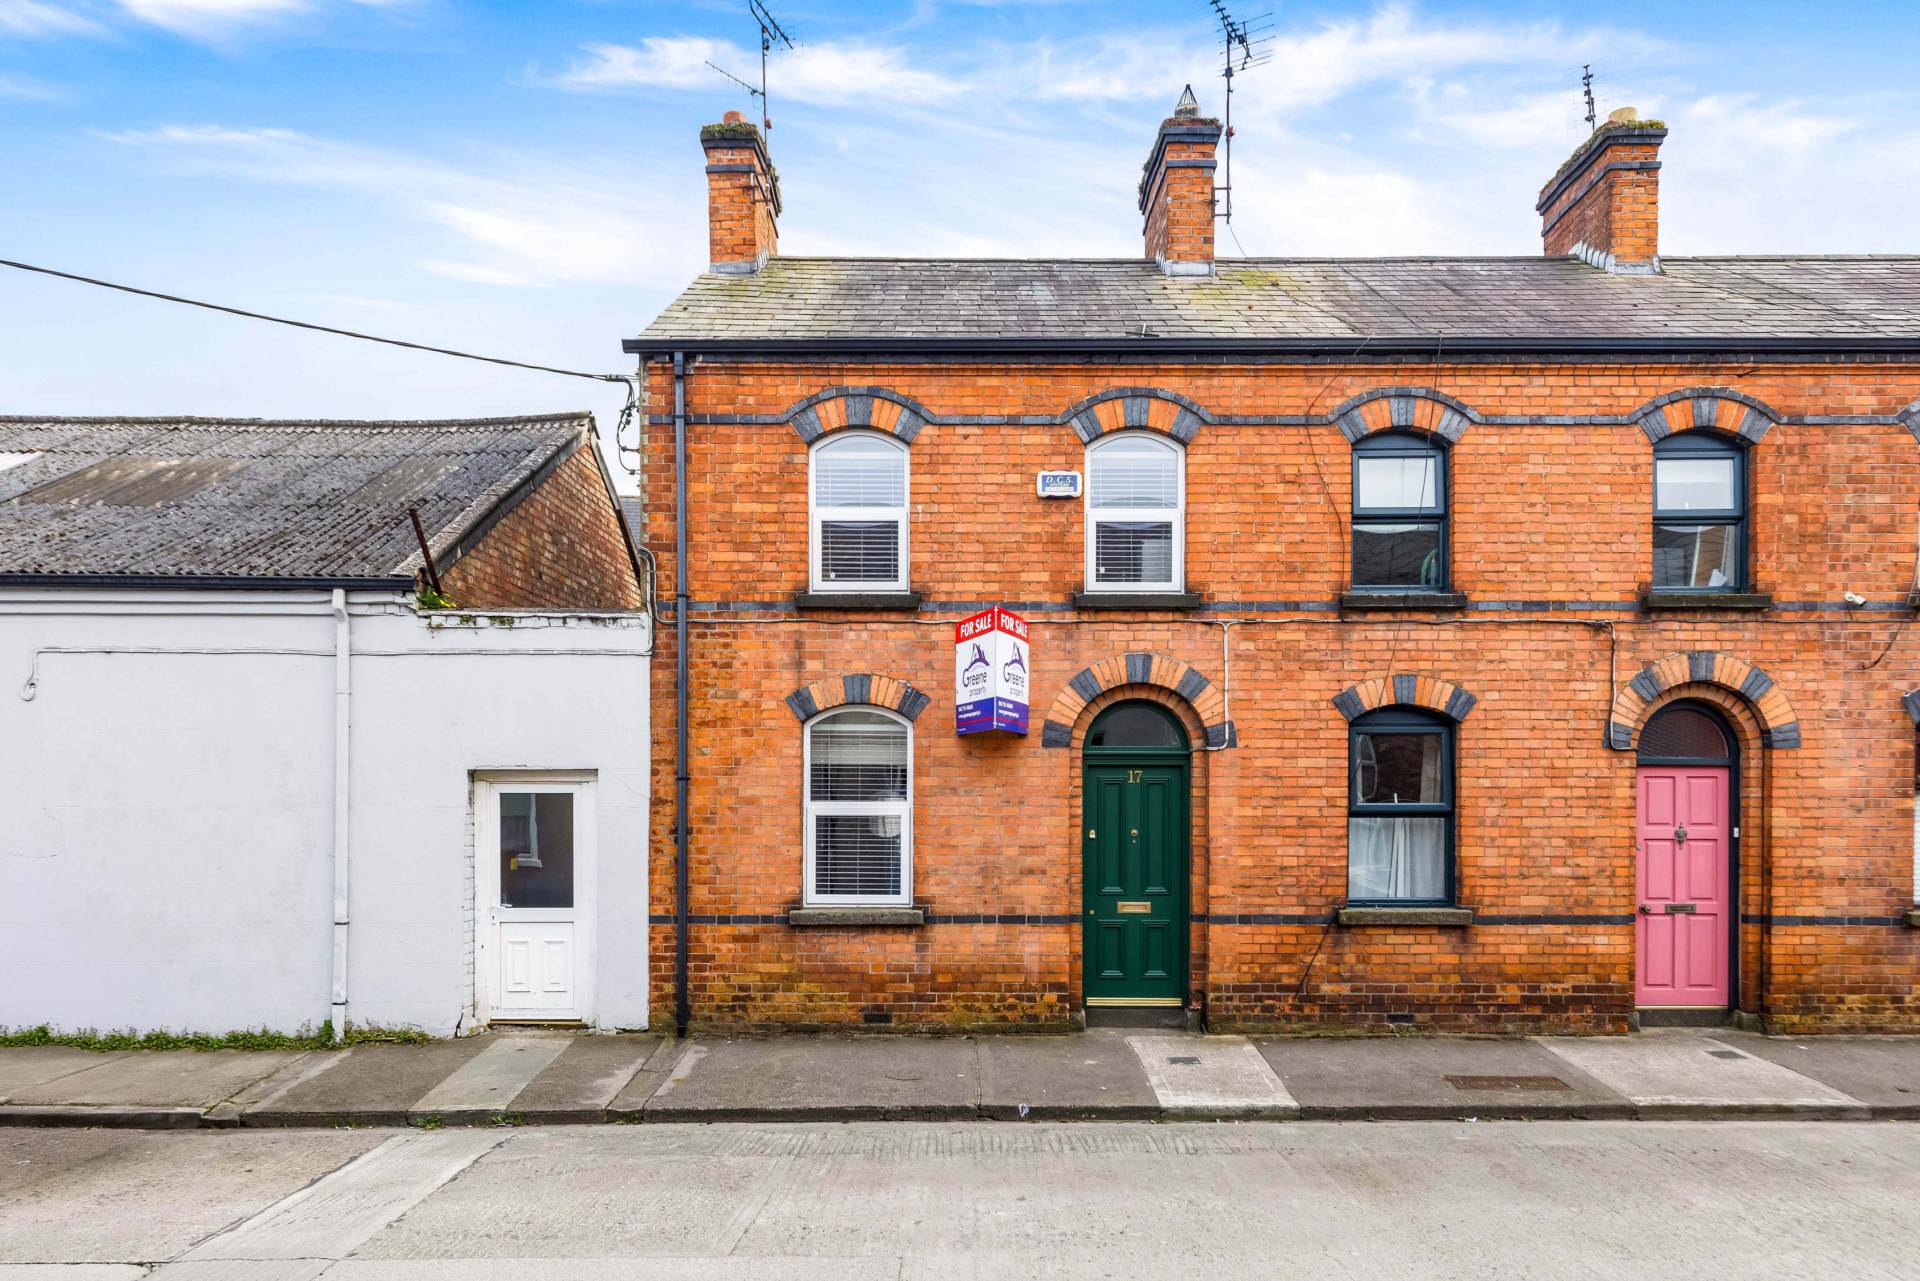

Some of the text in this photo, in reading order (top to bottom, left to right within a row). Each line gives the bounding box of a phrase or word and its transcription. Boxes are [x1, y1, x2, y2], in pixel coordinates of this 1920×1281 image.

[960, 613, 992, 638] FOR SALE
[1000, 613, 1028, 638] FOR SALE
[963, 668, 987, 687] Greene
[1003, 662, 1025, 687] Greene
[1127, 770, 1143, 784] 17
